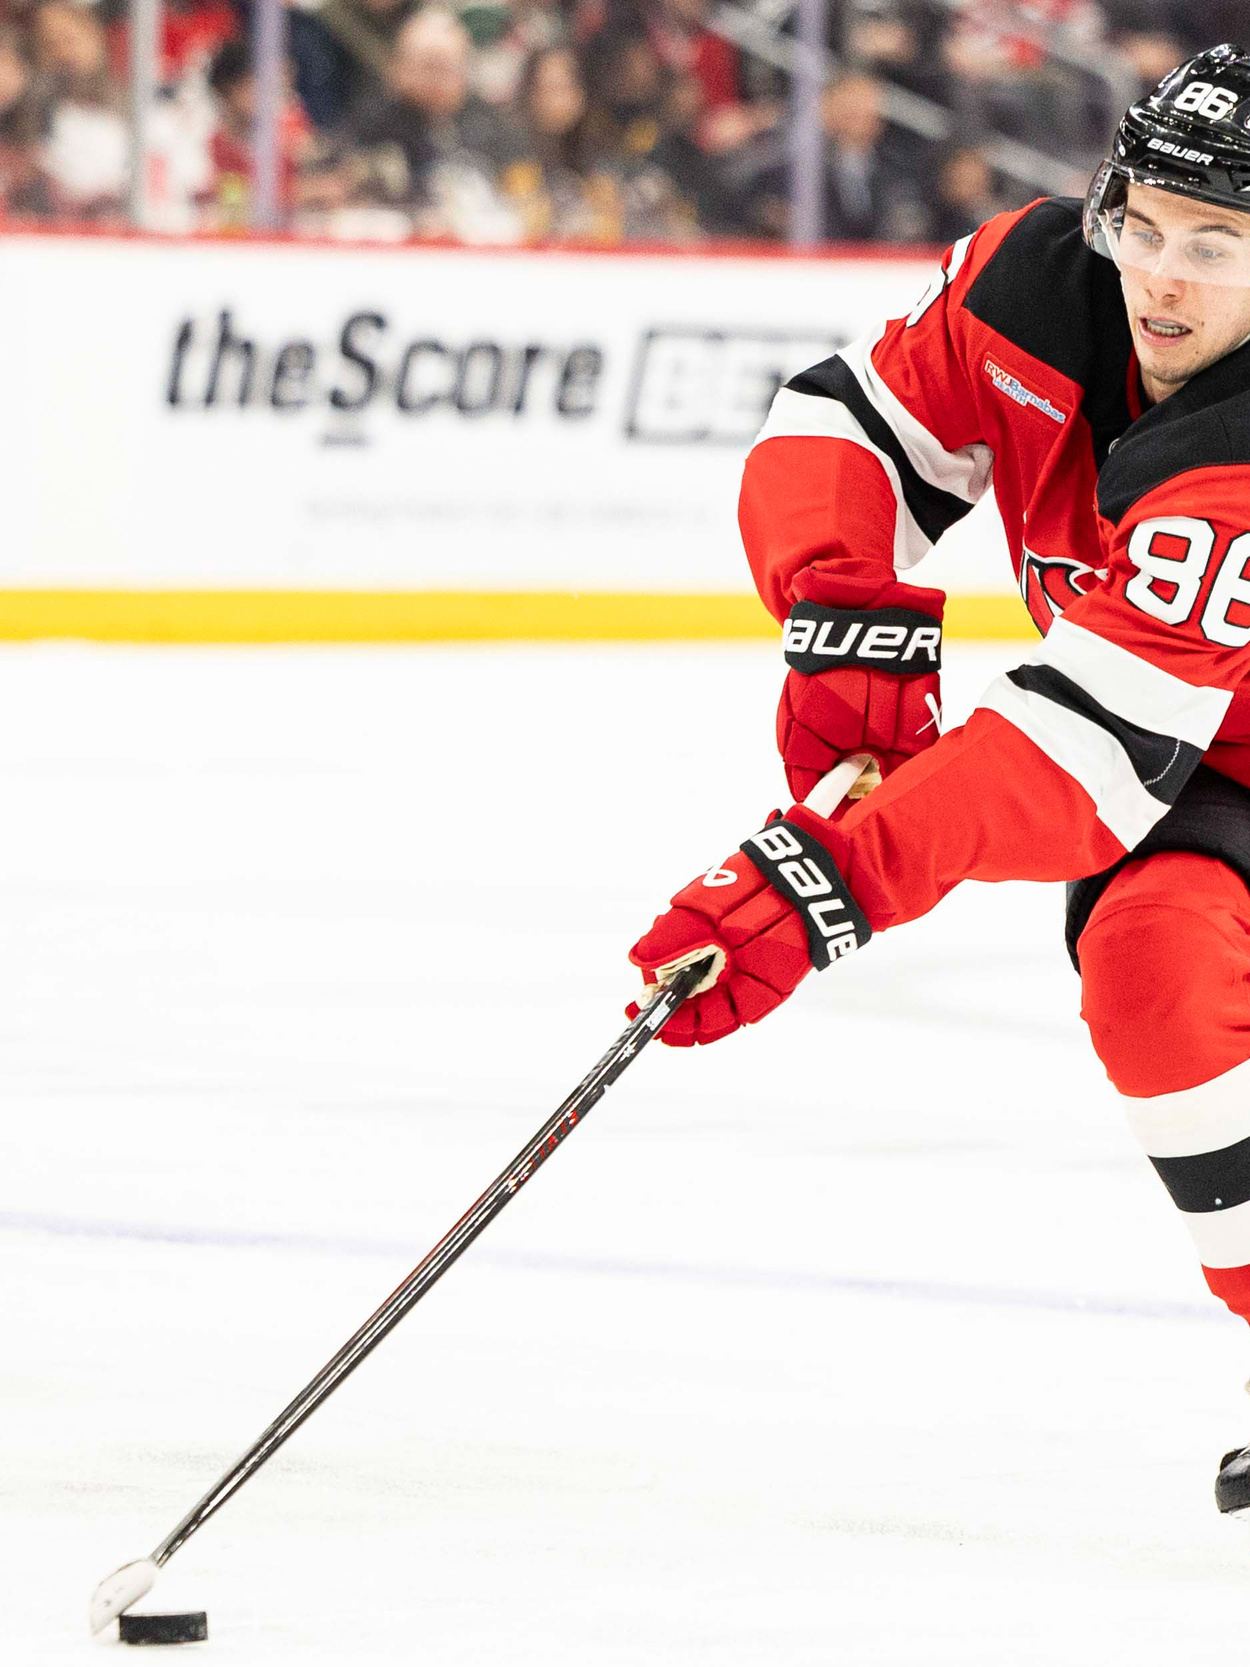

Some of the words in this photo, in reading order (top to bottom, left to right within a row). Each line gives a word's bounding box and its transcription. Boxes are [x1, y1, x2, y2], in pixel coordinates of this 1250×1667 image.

[1173, 81, 1239, 121] 86
[1147, 138, 1214, 166] BAUER
[166, 304, 606, 416] theScore
[749, 825, 859, 963] BAUE
